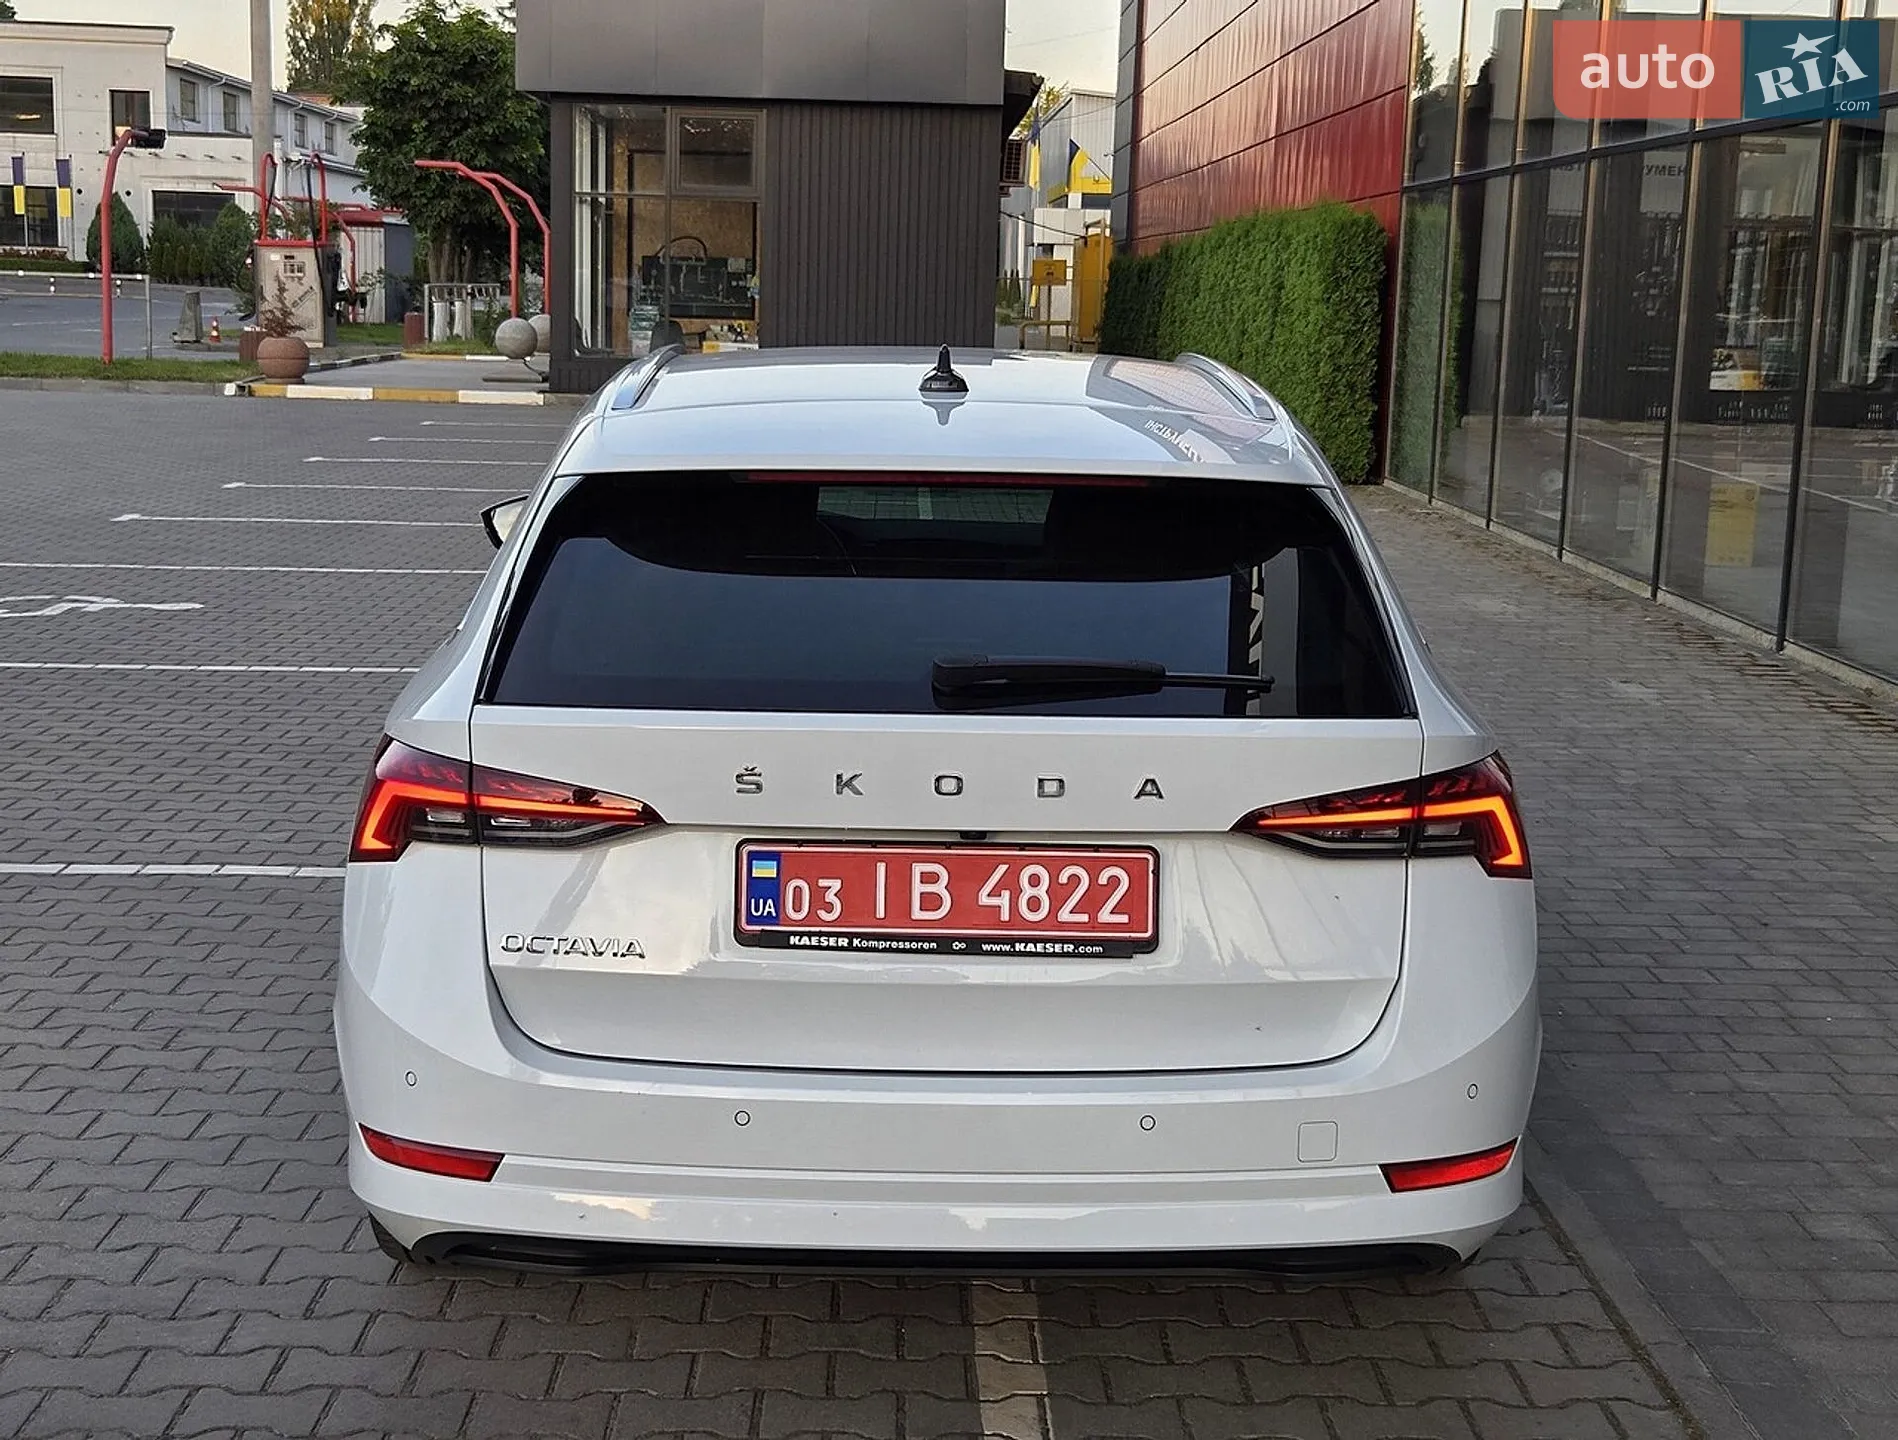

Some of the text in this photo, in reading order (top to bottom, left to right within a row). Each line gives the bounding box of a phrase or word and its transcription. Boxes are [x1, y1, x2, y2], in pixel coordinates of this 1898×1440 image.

[735, 766, 1164, 799] ŠKODA
[785, 861, 1130, 923] 03 IB 4822
[751, 898, 777, 916] UA
[500, 933, 646, 959] OCTAVIA
[789, 935, 1103, 953] KAESER Kompressoren www.KAESER.com
